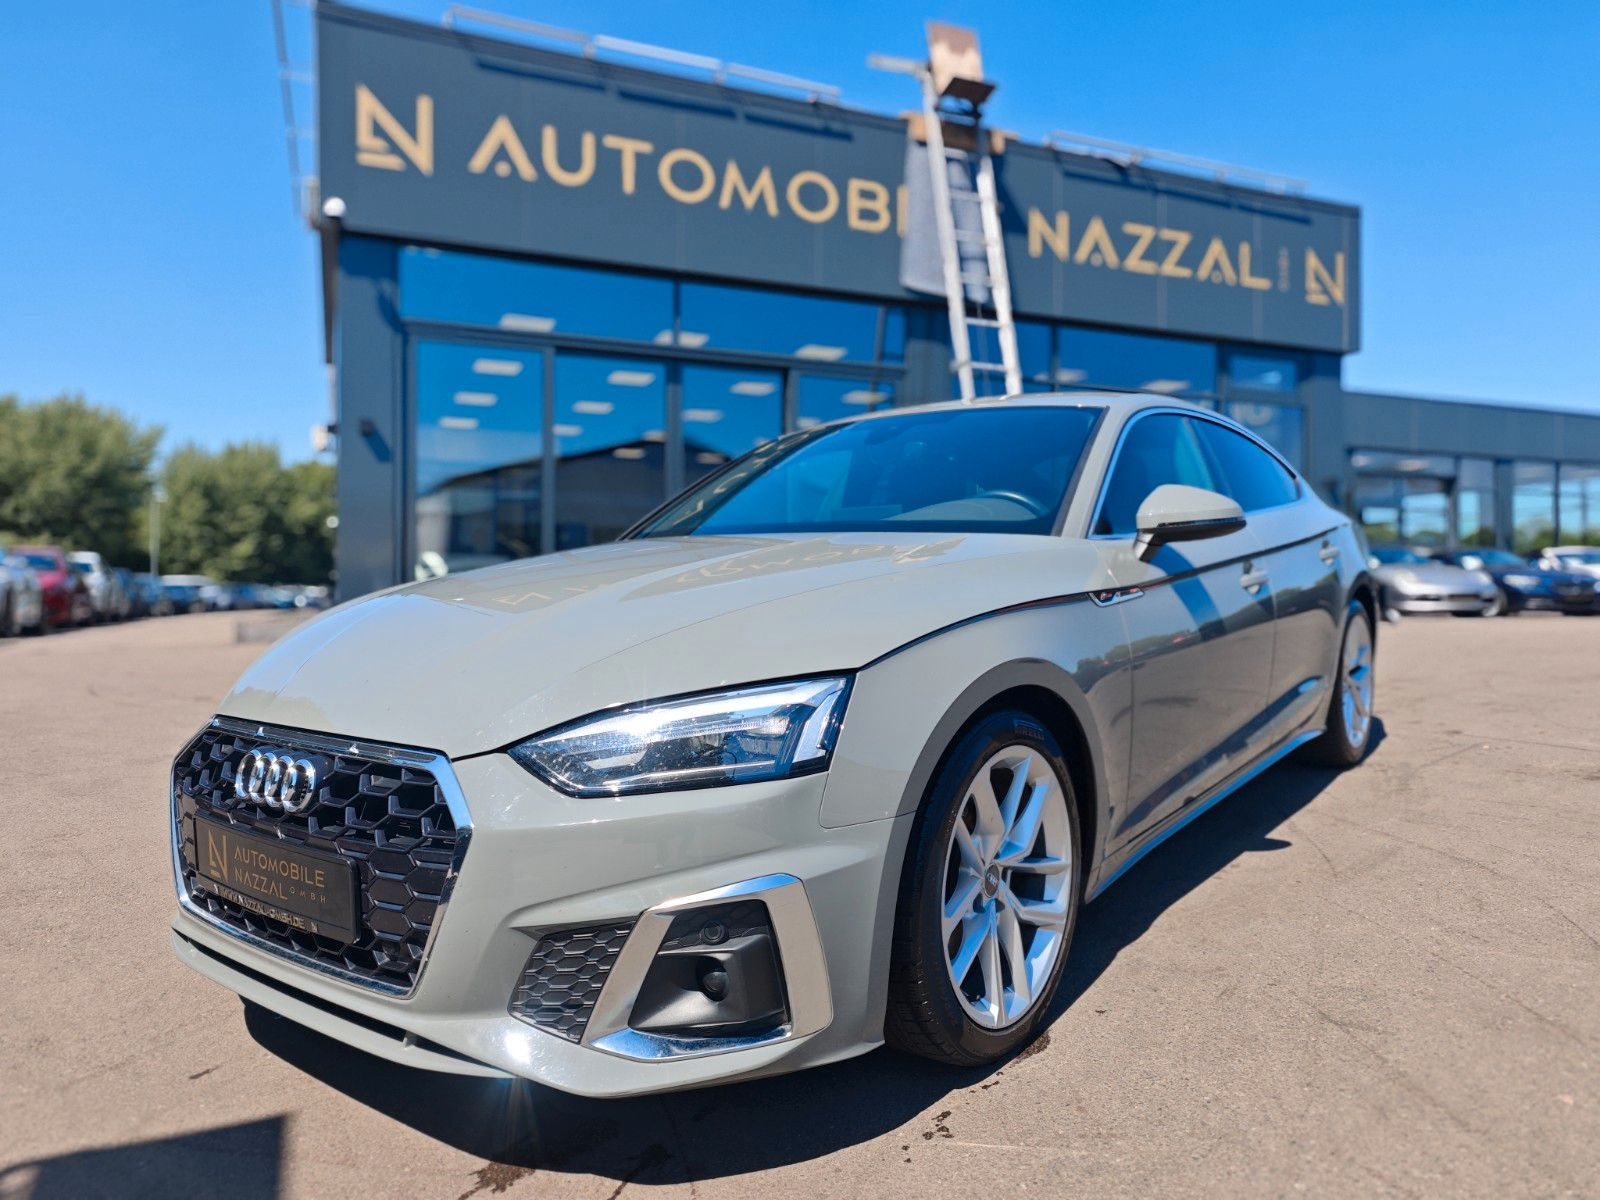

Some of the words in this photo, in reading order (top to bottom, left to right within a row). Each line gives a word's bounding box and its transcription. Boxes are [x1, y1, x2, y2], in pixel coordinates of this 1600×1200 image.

[468, 114, 909, 238] AUTOMOBI
[1027, 207, 1272, 291] NAZZAL
[234, 845, 325, 888] AUTOMOBILE
[234, 866, 288, 900] NAZZAL
